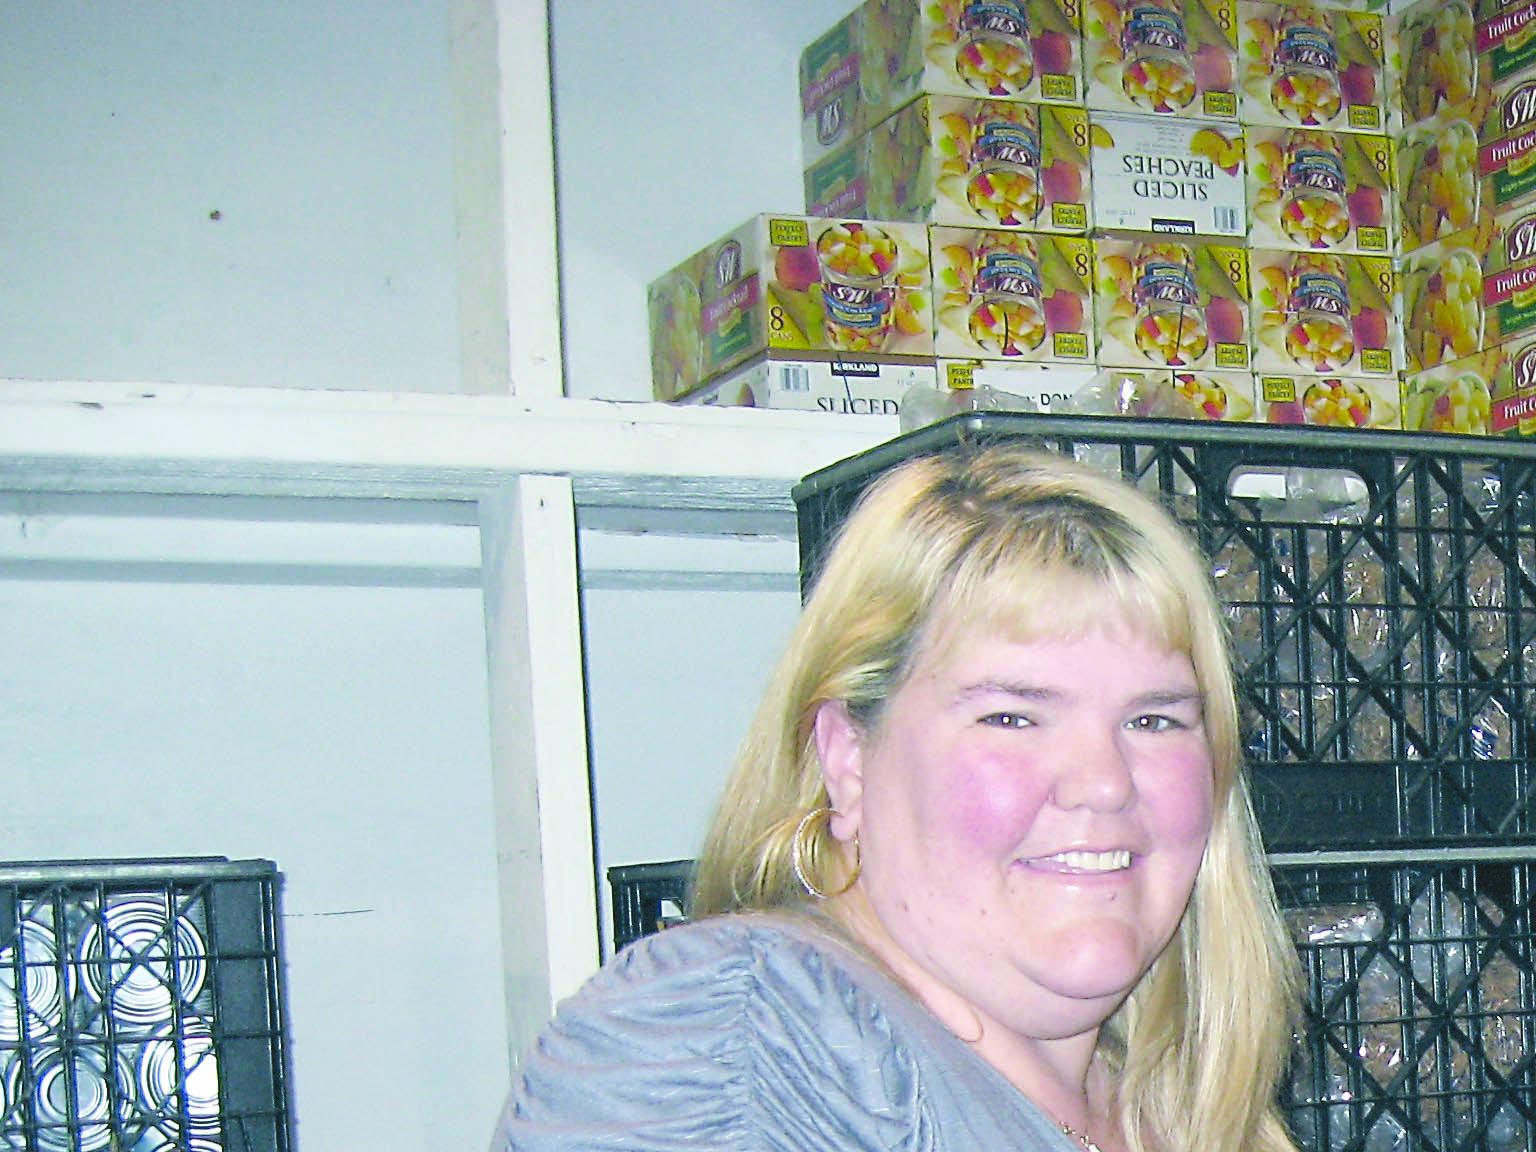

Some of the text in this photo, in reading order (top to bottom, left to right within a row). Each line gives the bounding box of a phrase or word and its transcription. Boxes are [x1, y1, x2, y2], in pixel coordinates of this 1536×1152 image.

[1218, 7, 1231, 30] 8
[1488, 15, 1512, 38] Fruit
[1367, 28, 1379, 50] 8
[1073, 123, 1087, 148] 8
[1375, 150, 1387, 172] 8
[1492, 138, 1517, 162] Fruit
[1122, 153, 1215, 181] PEACHES
[1133, 180, 1208, 201] SLICED
[1075, 253, 1088, 277] 8
[1229, 259, 1242, 283] 8
[1380, 272, 1391, 295] 8
[1496, 271, 1520, 293] Fruit
[770, 305, 785, 331] 8
[1504, 398, 1528, 419] Fruit
